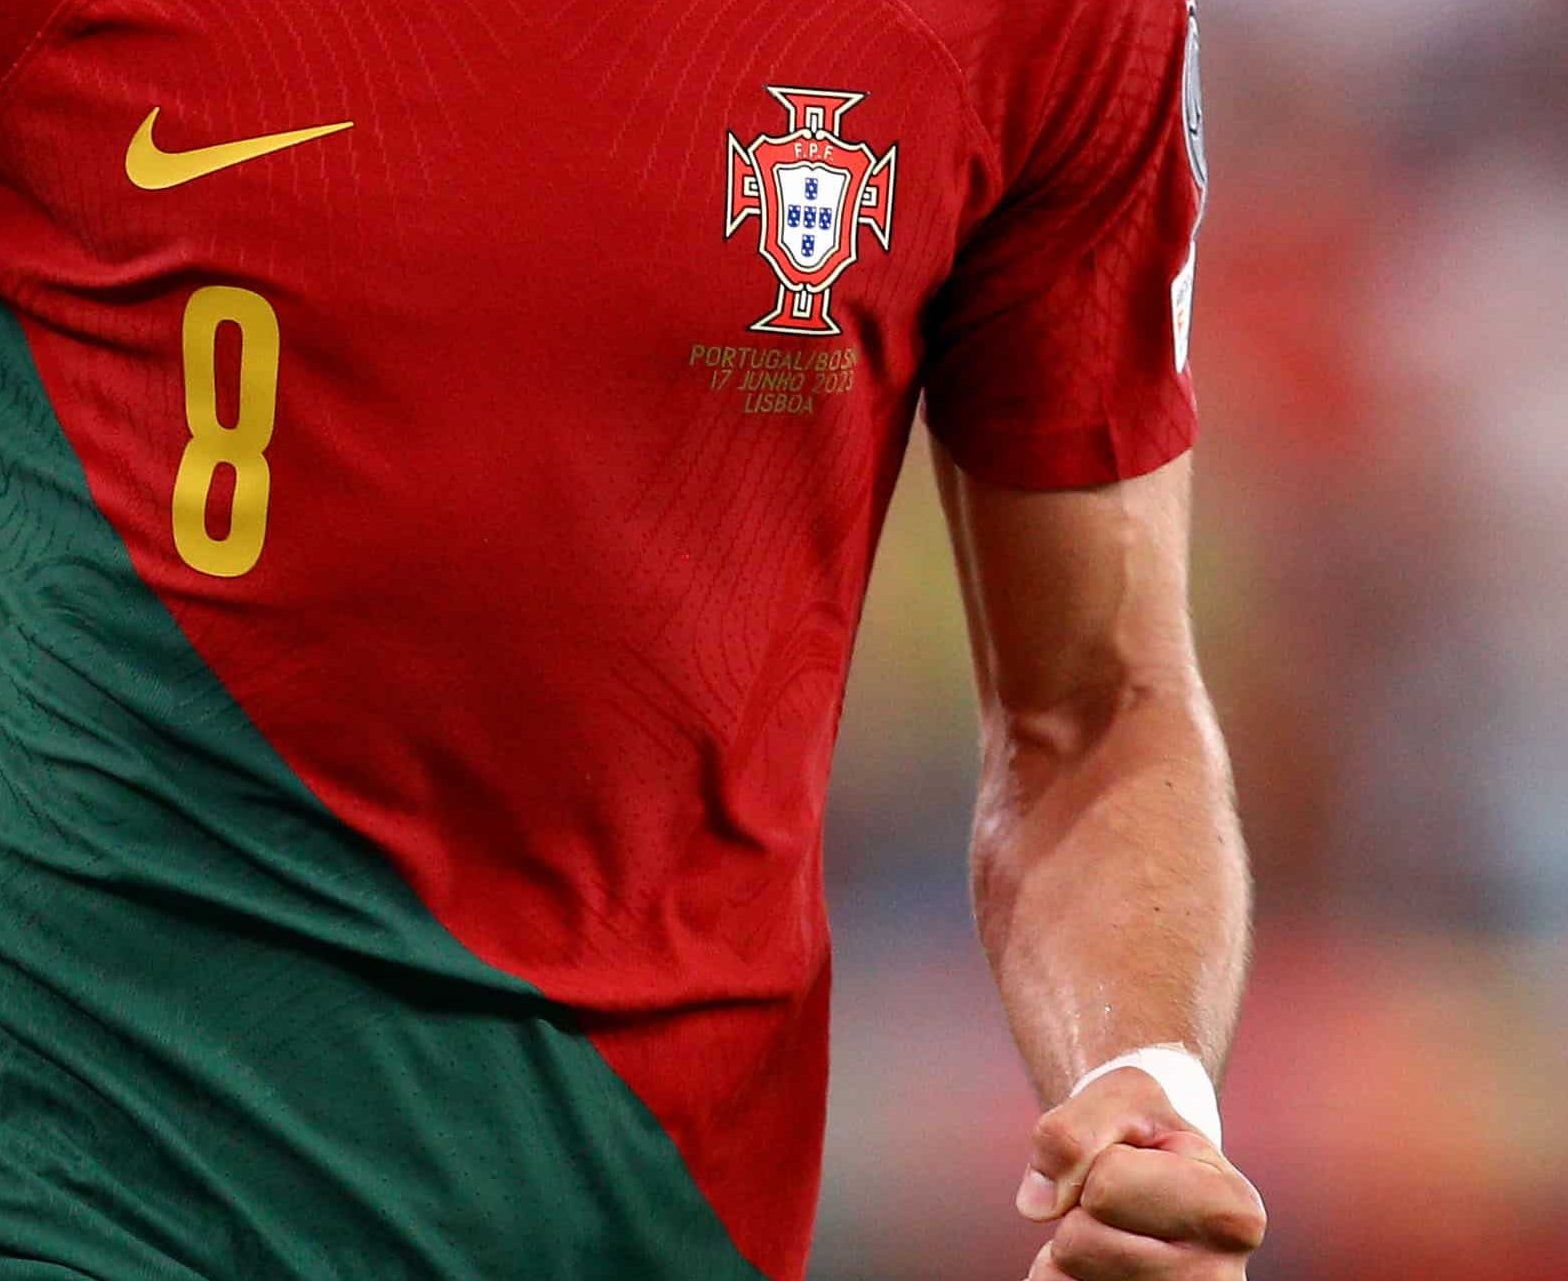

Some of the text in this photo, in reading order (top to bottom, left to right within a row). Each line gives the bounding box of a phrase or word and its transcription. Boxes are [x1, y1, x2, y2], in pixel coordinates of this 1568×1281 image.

[710, 369, 732, 391] 17
[737, 370, 805, 392] JUNHO
[744, 392, 814, 414] LISBOA
[172, 285, 280, 577] 8
